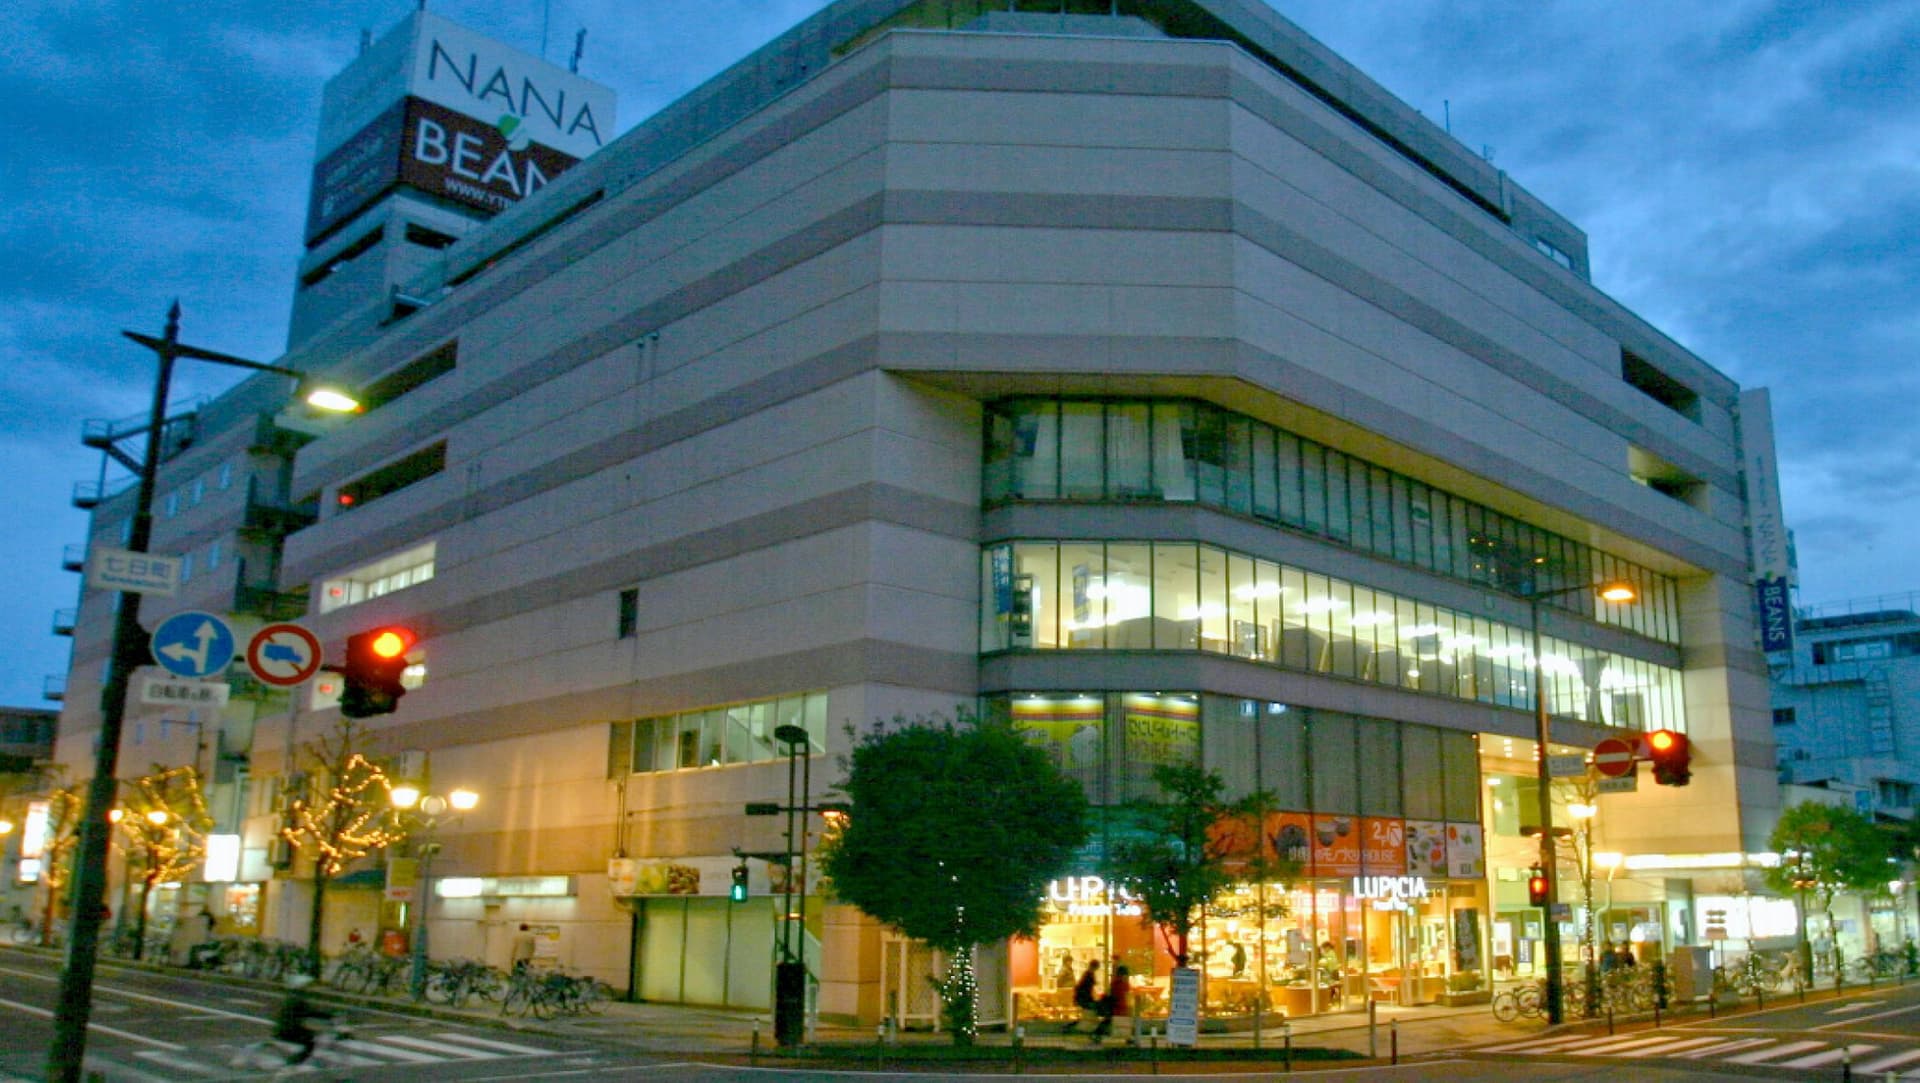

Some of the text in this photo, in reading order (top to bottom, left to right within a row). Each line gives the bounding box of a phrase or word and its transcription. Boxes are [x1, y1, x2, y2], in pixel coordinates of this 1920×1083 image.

[429, 39, 603, 145] NANA
[1757, 513, 1778, 566] NANA
[1764, 586, 1785, 642] BEANS
[1353, 875, 1427, 899] LUPICIA
